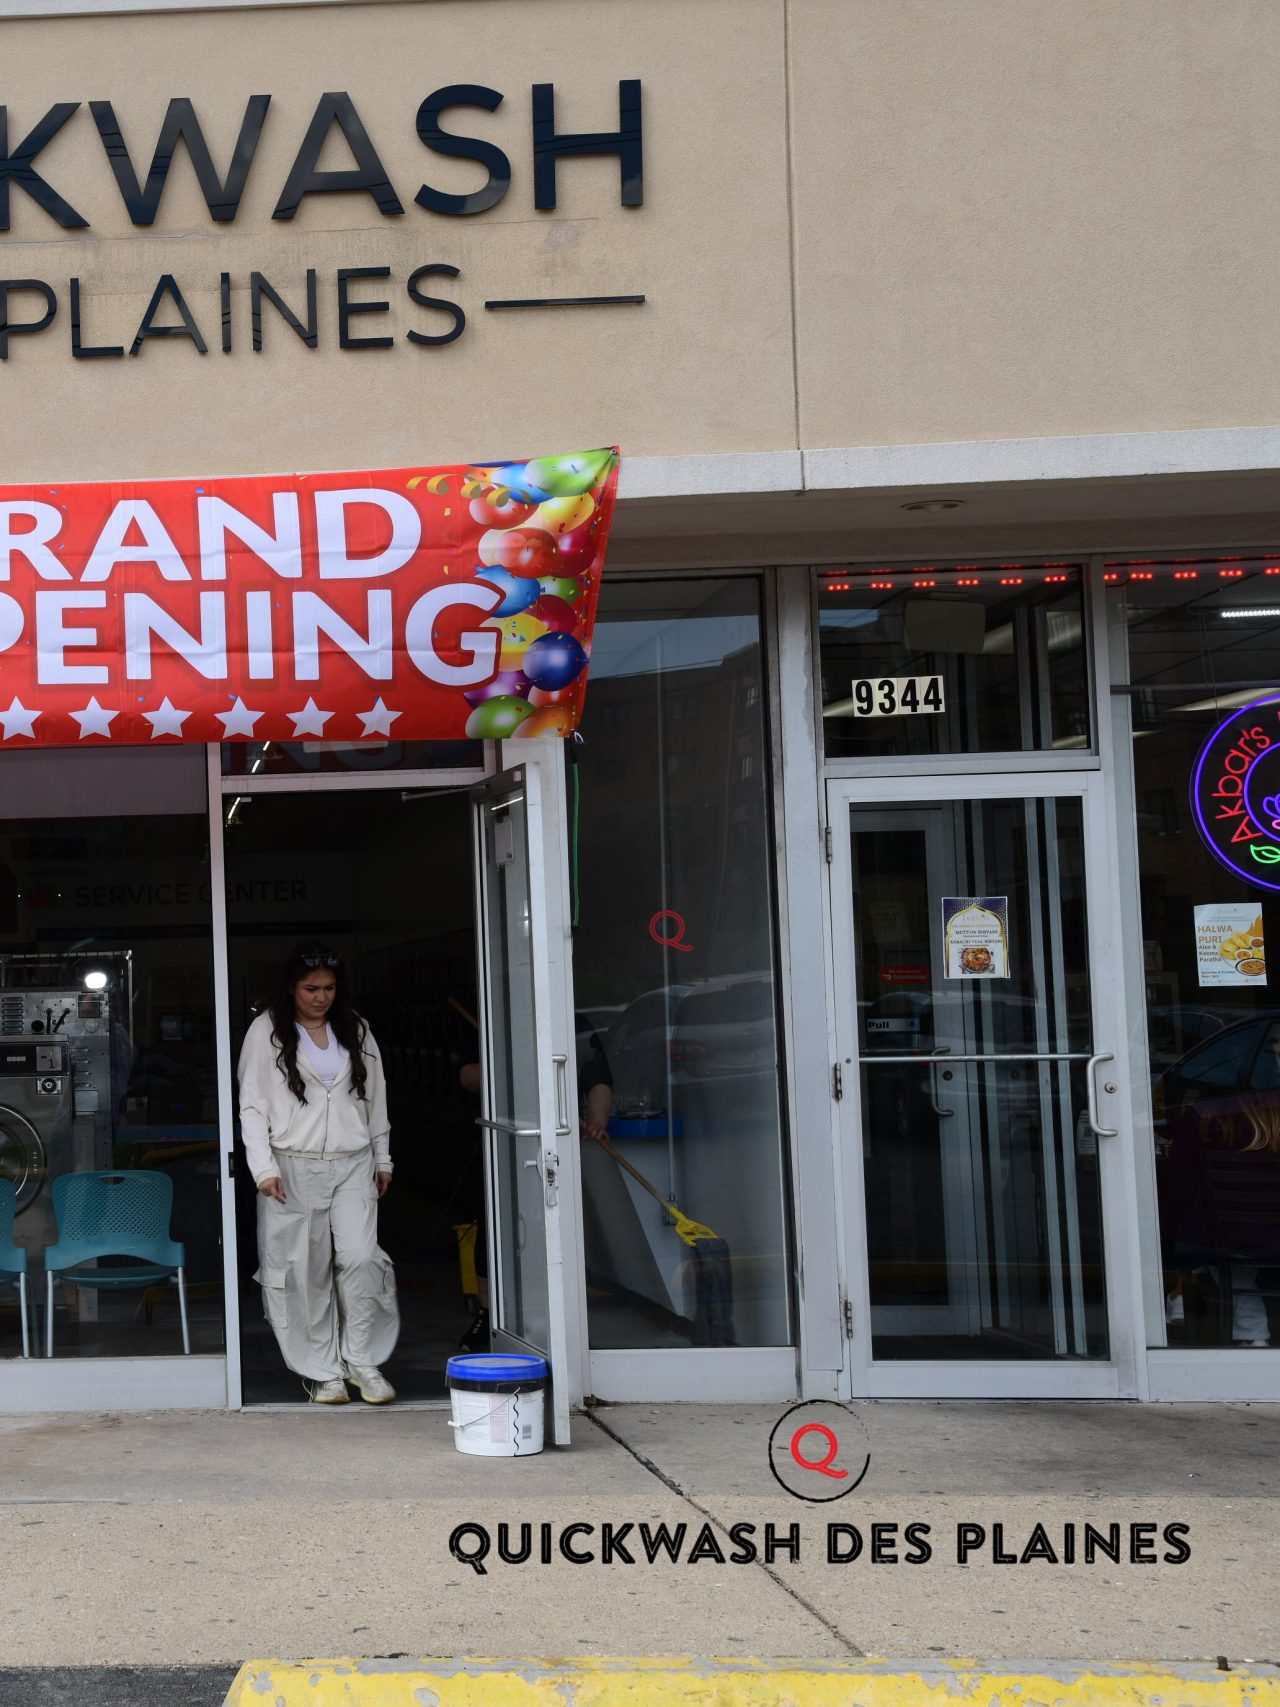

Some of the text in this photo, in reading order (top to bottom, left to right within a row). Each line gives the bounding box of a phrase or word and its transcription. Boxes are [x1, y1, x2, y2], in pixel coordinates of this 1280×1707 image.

[855, 677, 943, 716] 9344
[1211, 726, 1271, 843] Akbar's
[75, 883, 191, 906] SERVICE
[649, 909, 695, 952] Q
[1198, 924, 1233, 933] HALWA
[1198, 935, 1223, 944] PURI
[868, 1021, 890, 1029] Pull
